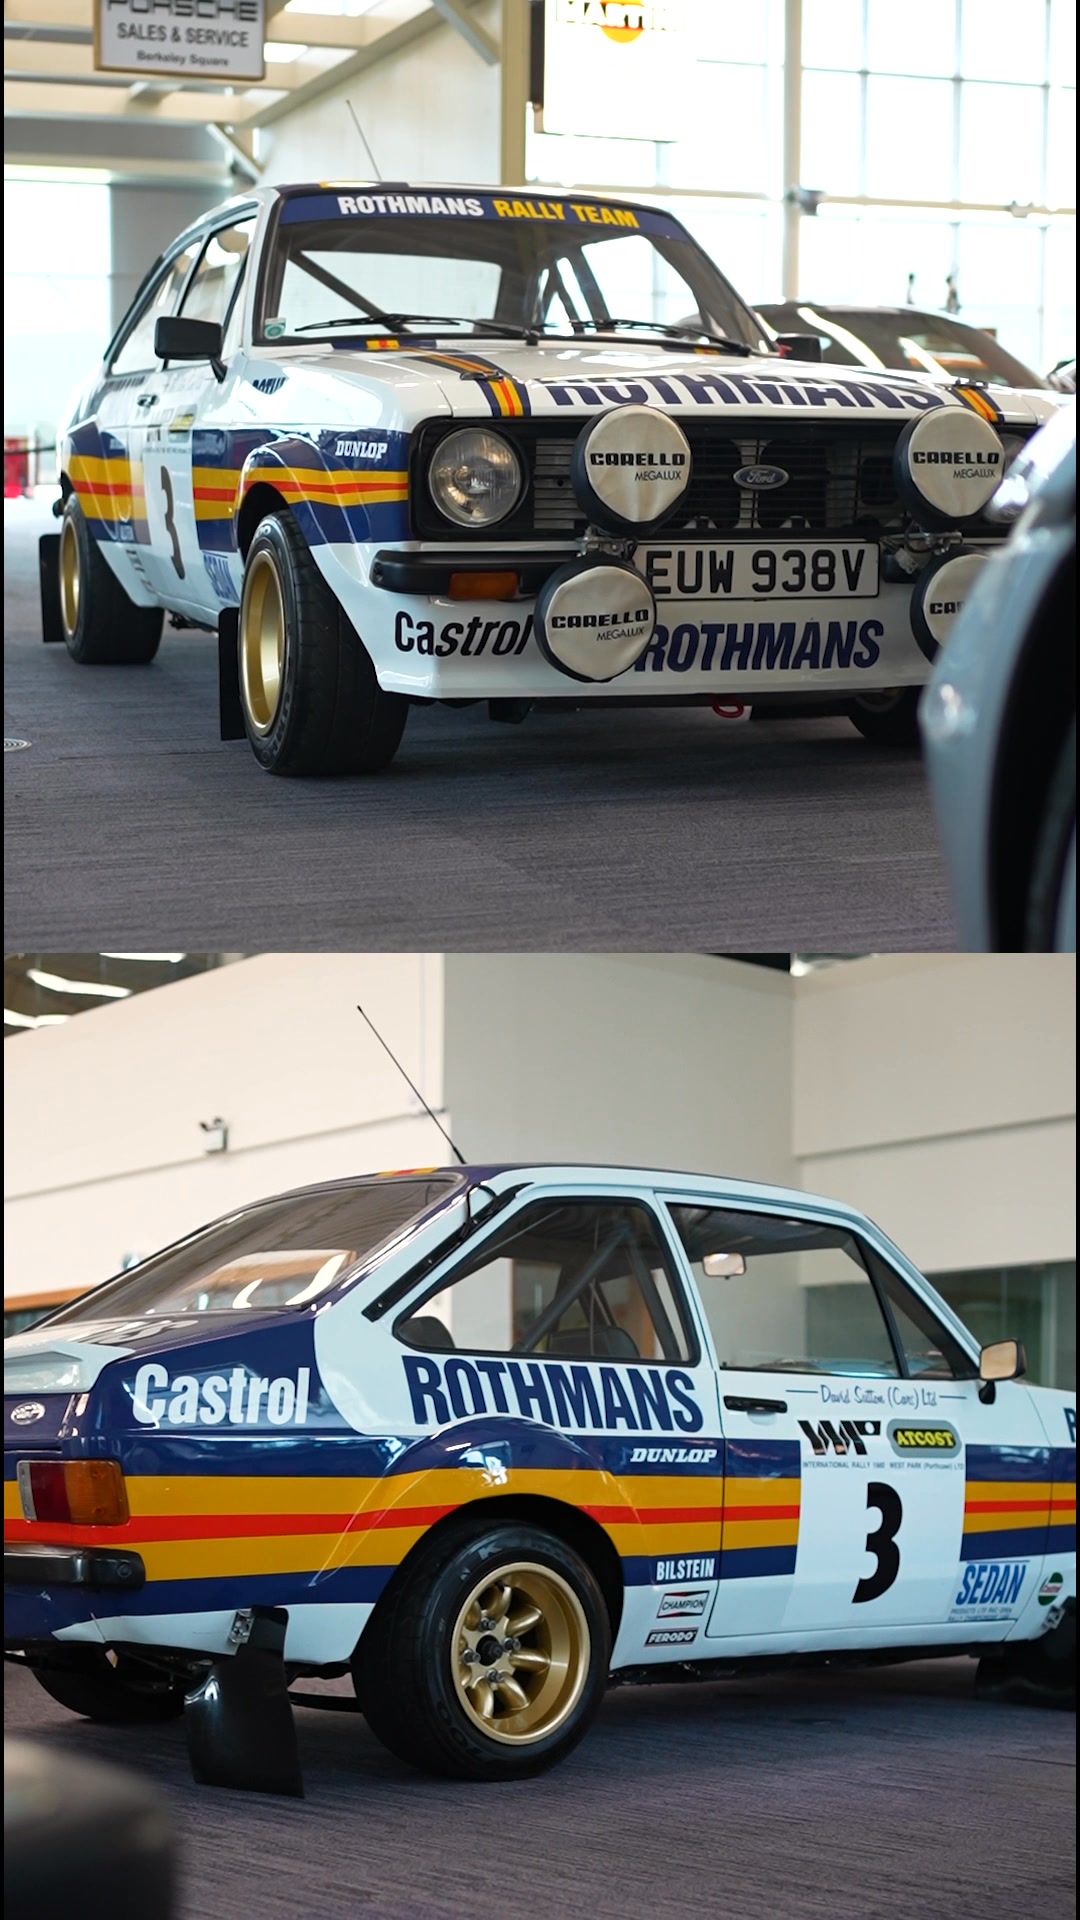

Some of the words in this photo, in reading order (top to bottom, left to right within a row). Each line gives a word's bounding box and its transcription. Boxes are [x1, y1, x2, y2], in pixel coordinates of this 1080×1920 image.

[117, 22, 167, 42] SALES
[170, 27, 181, 42] &
[186, 28, 249, 48] SERVICE
[136, 50, 187, 66] Berkeley
[189, 54, 229, 67] Square
[337, 196, 484, 217] ROTHMANS
[492, 199, 566, 221] RALLY
[570, 204, 640, 229] TEAM
[335, 440, 388, 459] DUNLOP
[913, 451, 1000, 465] CARELLO
[590, 453, 685, 467] CARELLO
[634, 470, 682, 482] MEGALUX
[746, 470, 776, 485] Ford
[952, 468, 996, 479] MEGALUX
[646, 550, 734, 594] EUW
[752, 549, 865, 594] 938V
[551, 609, 649, 629] CARELLO
[394, 610, 534, 657] Castrol
[596, 626, 645, 641] MEGALUX
[634, 619, 884, 672] ROTHMANS
[132, 1363, 311, 1426] Castrol
[401, 1355, 704, 1433] ROTHMANS
[820, 1384, 851, 1405] David
[854, 1385, 885, 1404] Sutton
[921, 1388, 938, 1407] Ltd
[897, 1430, 954, 1447] ATCOST
[630, 1448, 717, 1464] DUNLOP
[803, 1461, 849, 1469] INTERNATIONAL
[852, 1461, 870, 1469] RALLY
[851, 1481, 903, 1604] 3
[656, 1558, 716, 1581] BILSTEIN
[955, 1564, 1027, 1606] SEDAN
[662, 1599, 706, 1611] CHAMPION
[648, 1632, 694, 1644] FERODO
